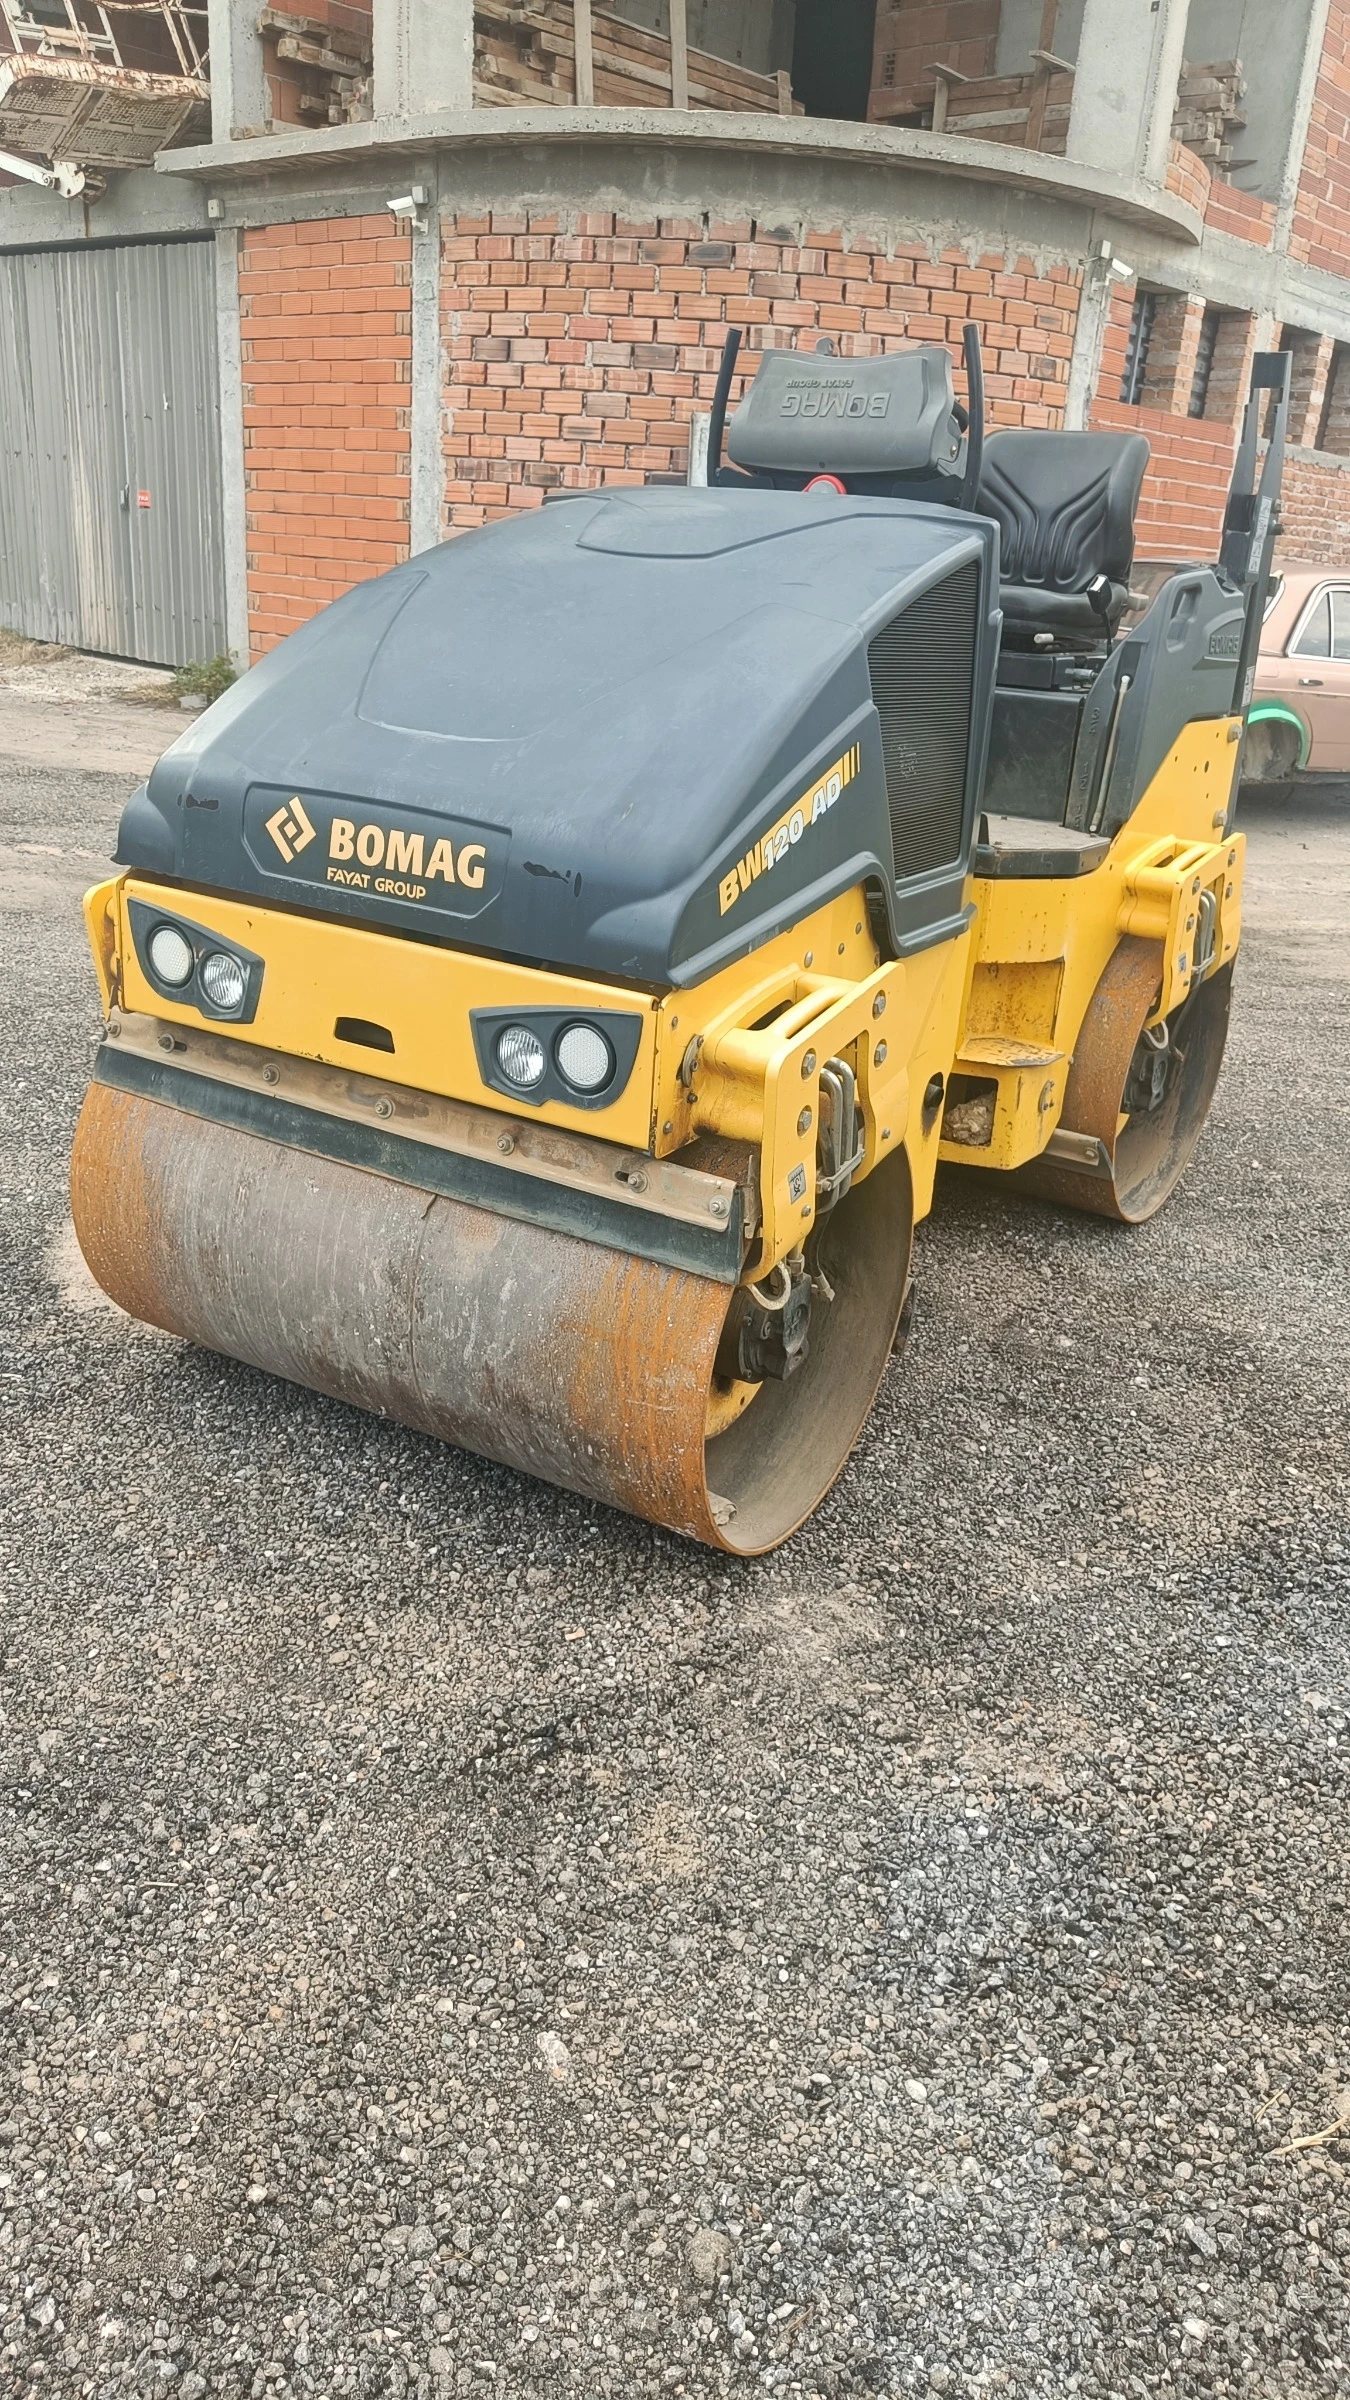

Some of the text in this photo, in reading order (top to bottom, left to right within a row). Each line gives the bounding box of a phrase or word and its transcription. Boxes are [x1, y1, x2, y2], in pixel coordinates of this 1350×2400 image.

[779, 392, 891, 418] BOMAG
[811, 772, 841, 825] AD
[328, 818, 487, 889] BOMAG
[326, 867, 427, 900] FAYAT GROUP
